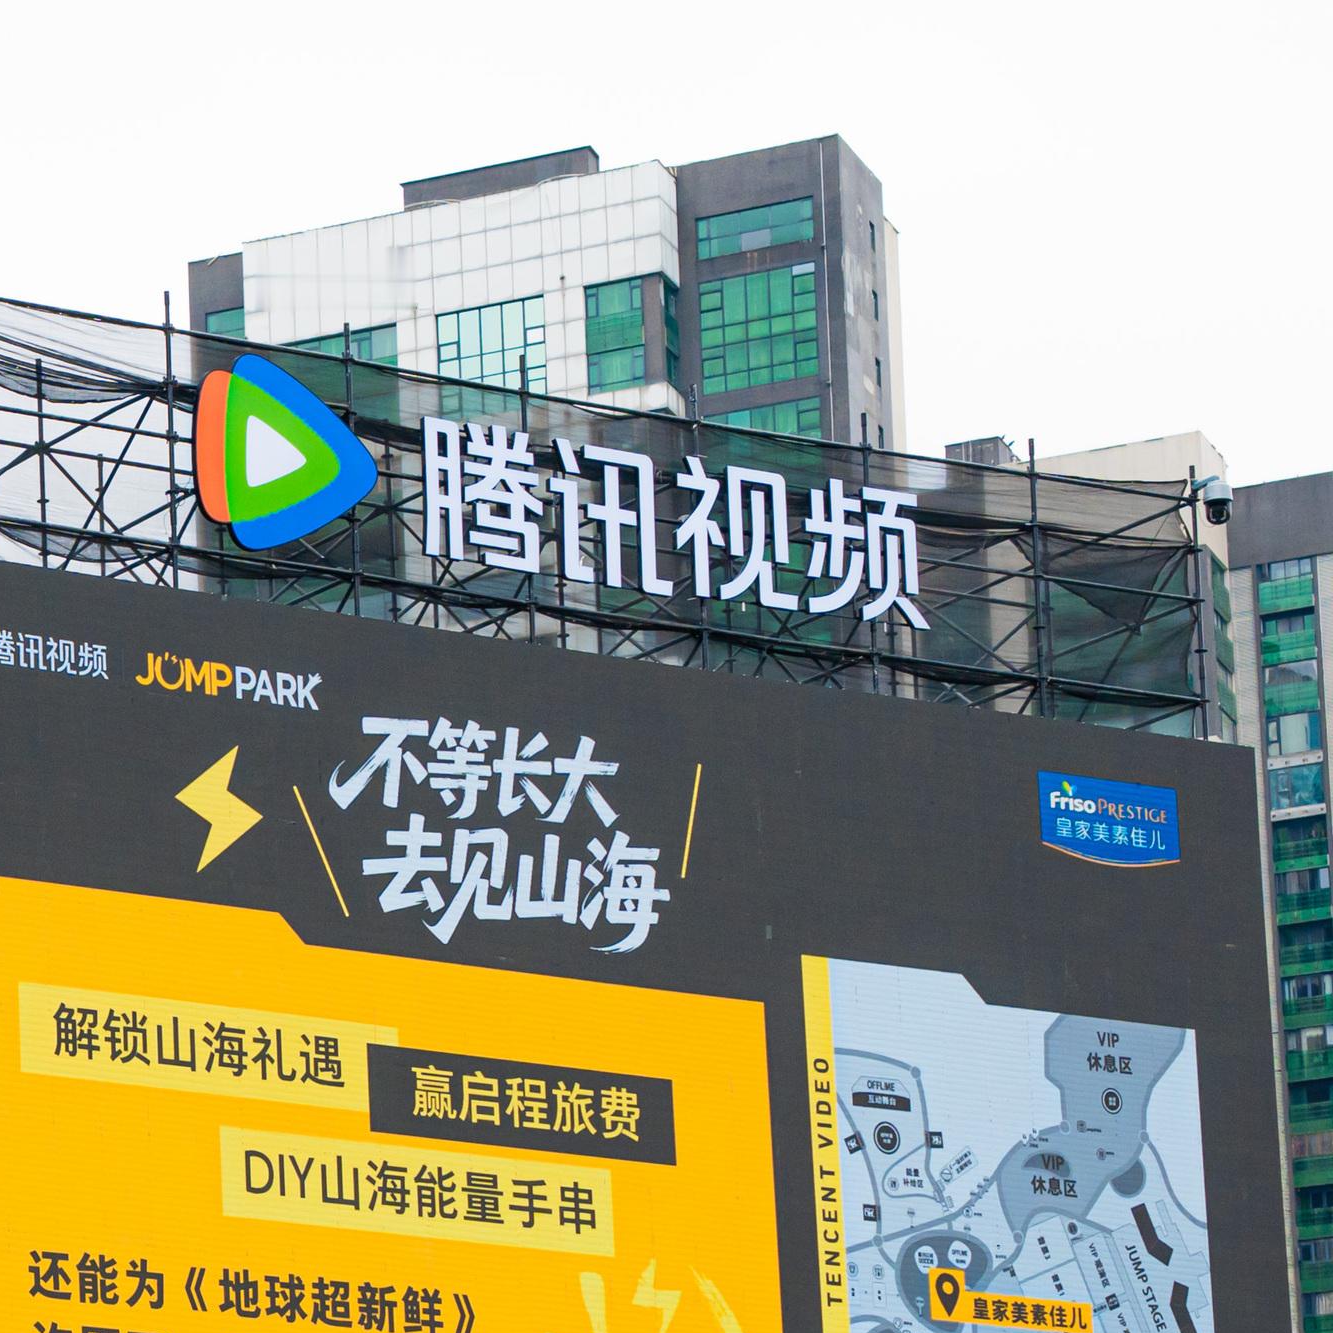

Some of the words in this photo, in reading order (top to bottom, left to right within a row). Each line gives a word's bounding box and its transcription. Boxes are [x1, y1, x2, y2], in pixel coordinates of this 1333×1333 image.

[421, 416, 931, 630] 腾讯视频
[135, 652, 233, 696] JUMP
[235, 666, 323, 711] PARK
[329, 716, 620, 827] 不等长大
[1049, 789, 1096, 814] Friso
[1098, 798, 1168, 824] PRESTIGE
[1056, 817, 1166, 850] 皇家美素佳儿
[361, 813, 671, 954] 去见山海
[53, 1002, 345, 1088] 解锁山海礼遇
[1086, 1052, 1133, 1075] 休息区
[1096, 1031, 1120, 1048] VIP
[411, 1065, 641, 1142] 赢启程旅费
[813, 1058, 834, 1149] VIDEO
[244, 1150, 597, 1235] DIY山海能量手串
[1031, 1175, 1078, 1197] 休息区
[1042, 1154, 1064, 1171] VIP
[820, 1165, 843, 1306] TENCENT
[973, 1297, 1087, 1330] 皇家美素佳儿
[1125, 1244, 1149, 1284] JUMP
[1142, 1286, 1167, 1333] STAGE
